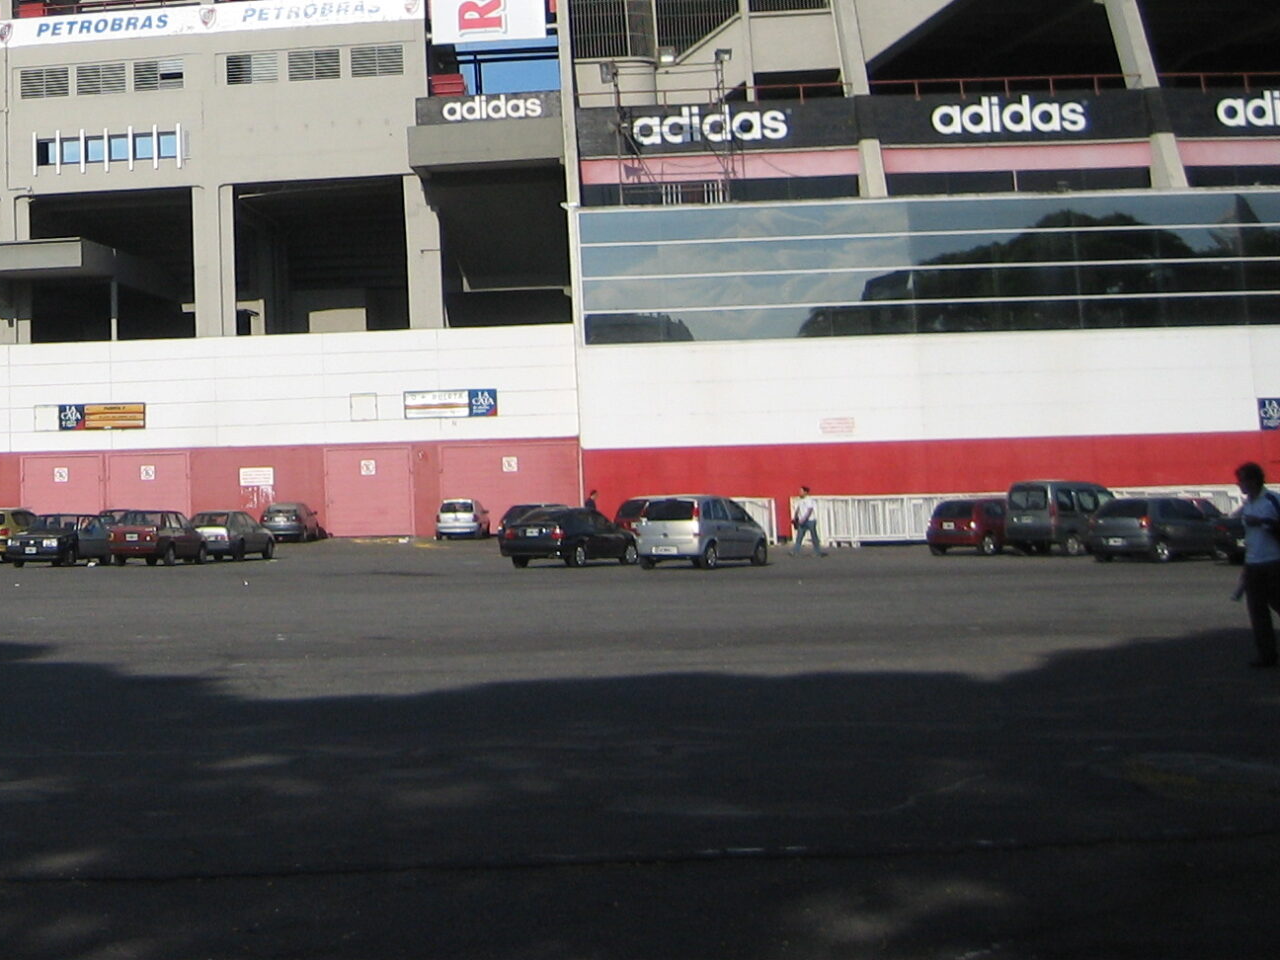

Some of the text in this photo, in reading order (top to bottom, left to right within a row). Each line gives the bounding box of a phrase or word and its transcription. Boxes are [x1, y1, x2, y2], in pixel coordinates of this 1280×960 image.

[36, 14, 169, 38] PETROBRAS
[442, 94, 542, 121] adidas
[931, 95, 1086, 134] adidas
[632, 104, 788, 145] adidas
